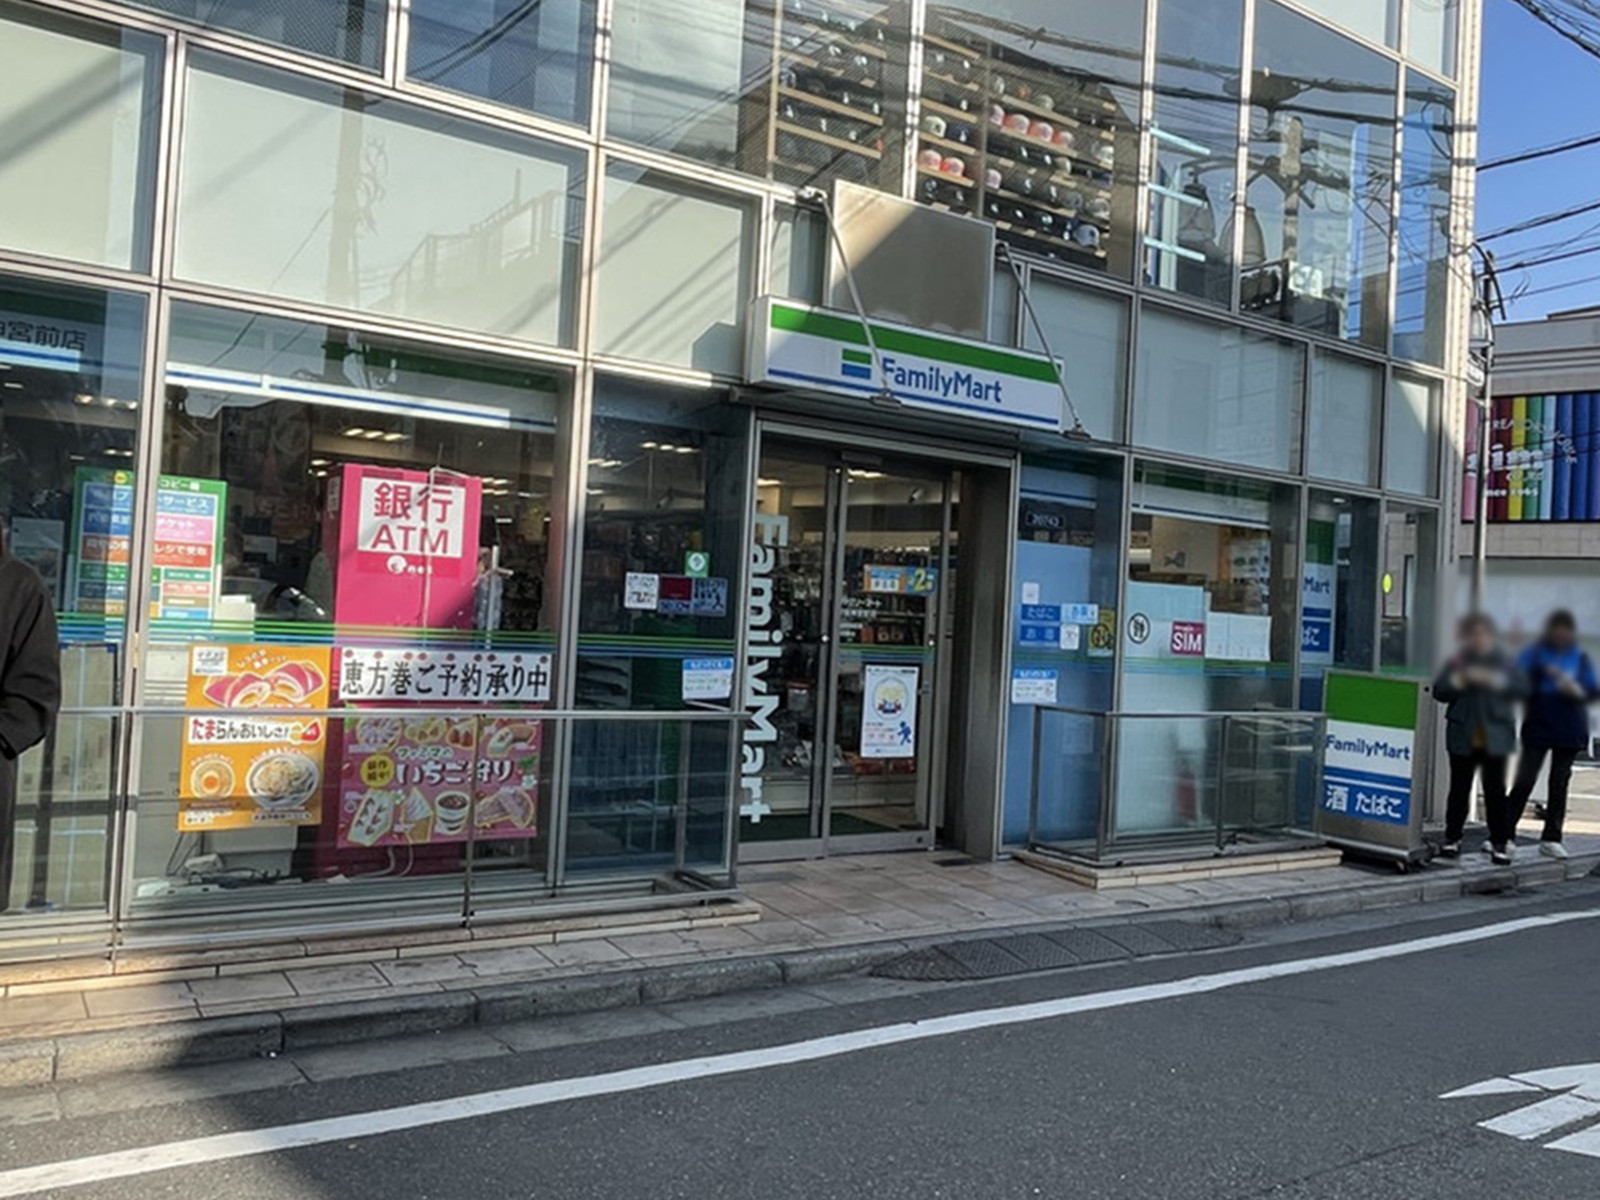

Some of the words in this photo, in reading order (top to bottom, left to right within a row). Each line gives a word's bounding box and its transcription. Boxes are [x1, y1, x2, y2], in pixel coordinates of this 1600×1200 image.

[881, 357, 1002, 404] FamilyMart
[373, 482, 454, 524] 銀行
[370, 523, 450, 555] ATM
[1303, 576, 1331, 594] Mart
[1172, 632, 1202, 652] SIM
[341, 659, 549, 699] 恵方巻ご予約承り中
[739, 514, 790, 824] FamilyMart
[1326, 734, 1411, 761] FamilyMart
[395, 759, 514, 787] いちご狩り
[1324, 784, 1349, 812] 酒
[1355, 791, 1402, 819] たばこ
